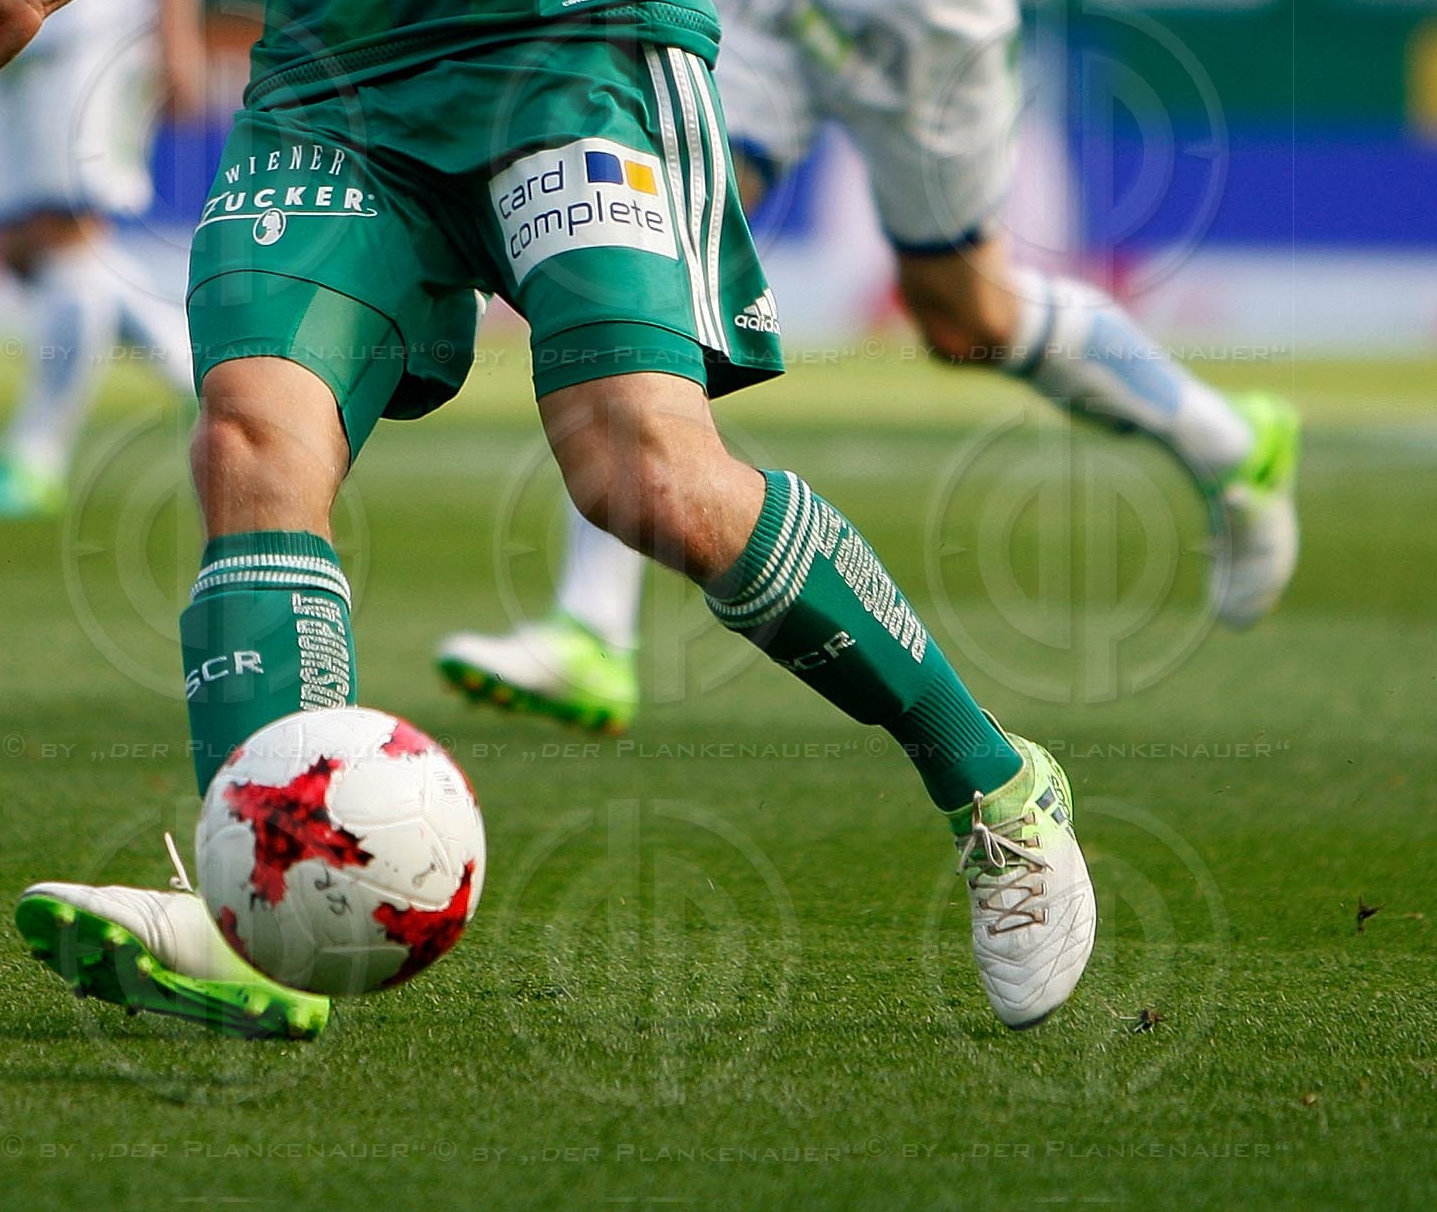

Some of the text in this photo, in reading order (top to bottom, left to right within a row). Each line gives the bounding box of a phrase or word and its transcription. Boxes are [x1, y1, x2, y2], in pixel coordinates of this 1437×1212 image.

[224, 144, 346, 185] WIENER
[498, 160, 564, 221] card
[509, 190, 665, 260] complete
